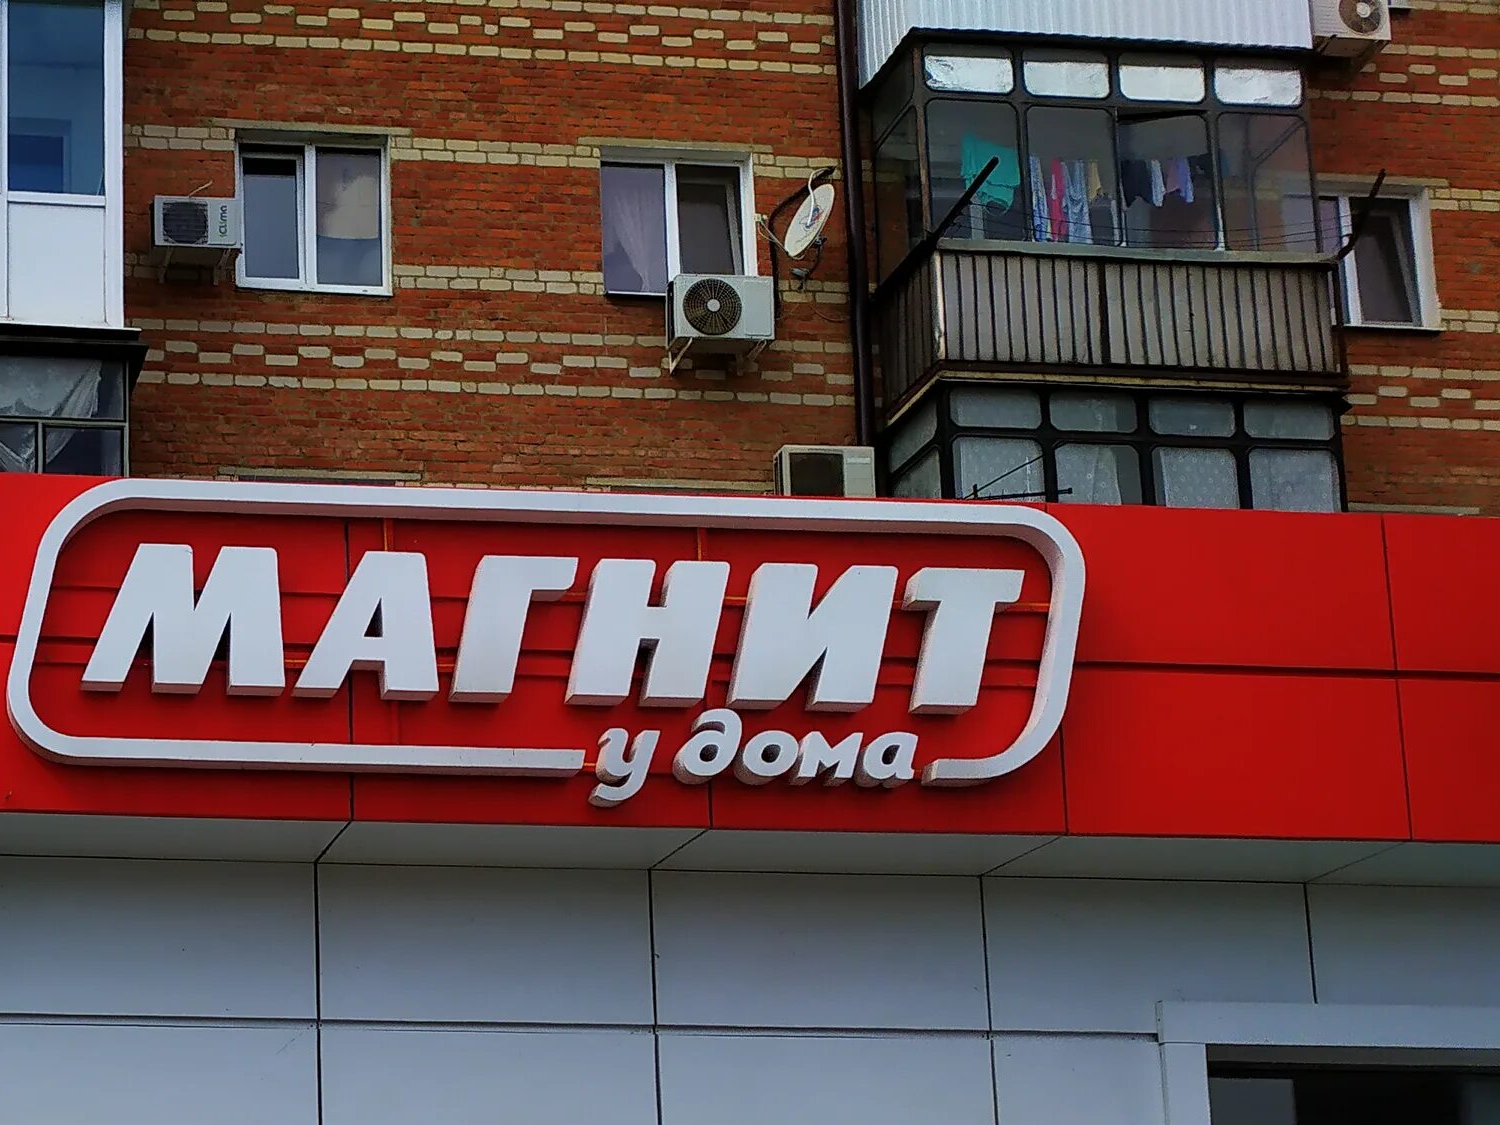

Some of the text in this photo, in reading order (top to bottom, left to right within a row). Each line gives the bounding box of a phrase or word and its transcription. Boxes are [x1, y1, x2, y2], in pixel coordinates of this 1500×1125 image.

[81, 542, 1025, 714] МАГНИТ
[588, 708, 919, 807] у дома
